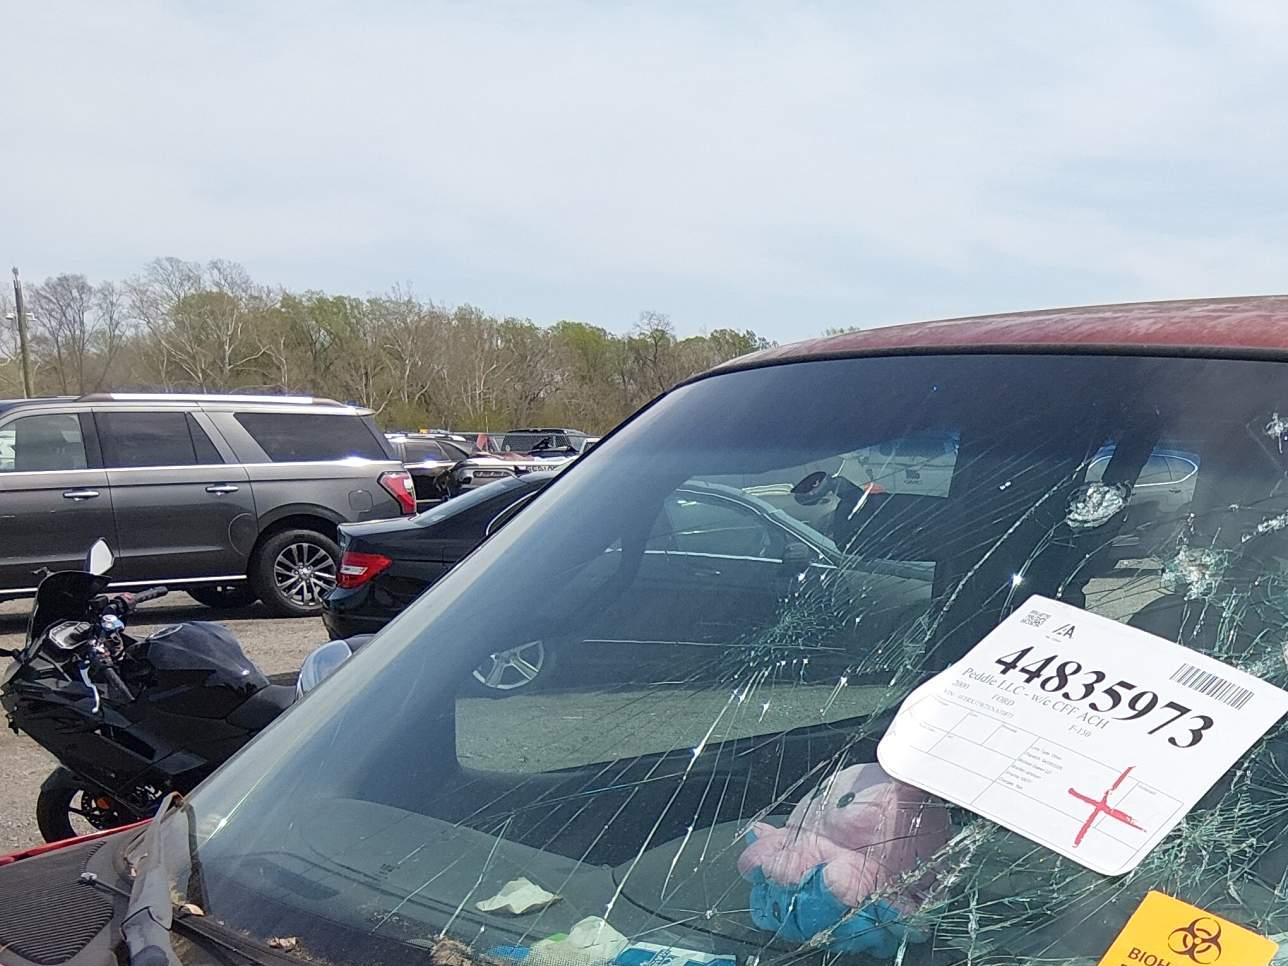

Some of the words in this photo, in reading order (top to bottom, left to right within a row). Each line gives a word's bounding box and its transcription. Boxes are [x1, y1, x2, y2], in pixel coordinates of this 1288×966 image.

[962, 667, 998, 686] Peddle
[997, 679, 1025, 696] LLC
[1052, 700, 1080, 716] CFF
[1076, 711, 1110, 729] ACH
[994, 645, 1215, 749] 44835973
